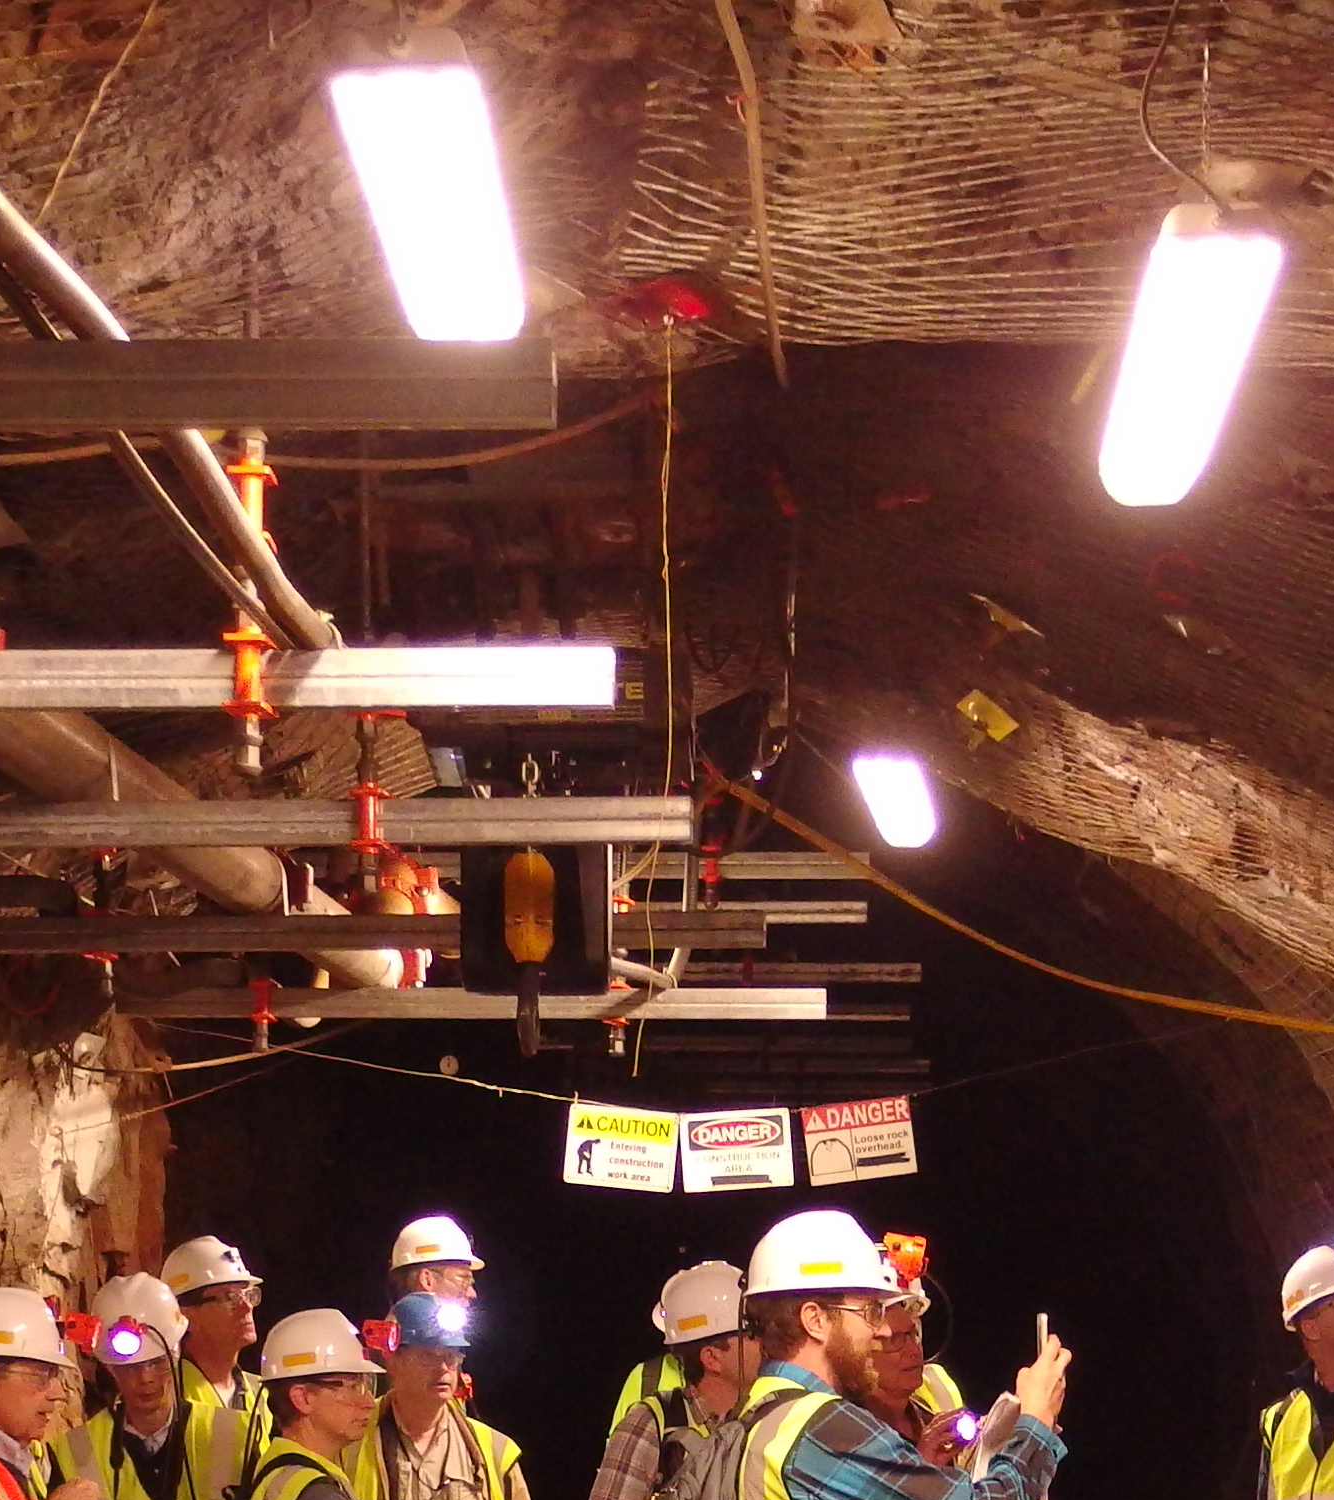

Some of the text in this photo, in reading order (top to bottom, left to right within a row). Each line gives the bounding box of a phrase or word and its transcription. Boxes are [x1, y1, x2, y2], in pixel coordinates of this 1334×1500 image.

[826, 1099, 910, 1128] DANGER
[597, 1116, 670, 1137] CAUTION
[698, 1124, 771, 1143] DANGER
[854, 1130, 909, 1144] Loose rock
[610, 1141, 647, 1154] Entering
[855, 1141, 904, 1154] overhead.
[609, 1156, 664, 1169] construction
[695, 1150, 780, 1163] CONSTRUCTION
[724, 1164, 753, 1173] AREA
[607, 1171, 651, 1182] work area
